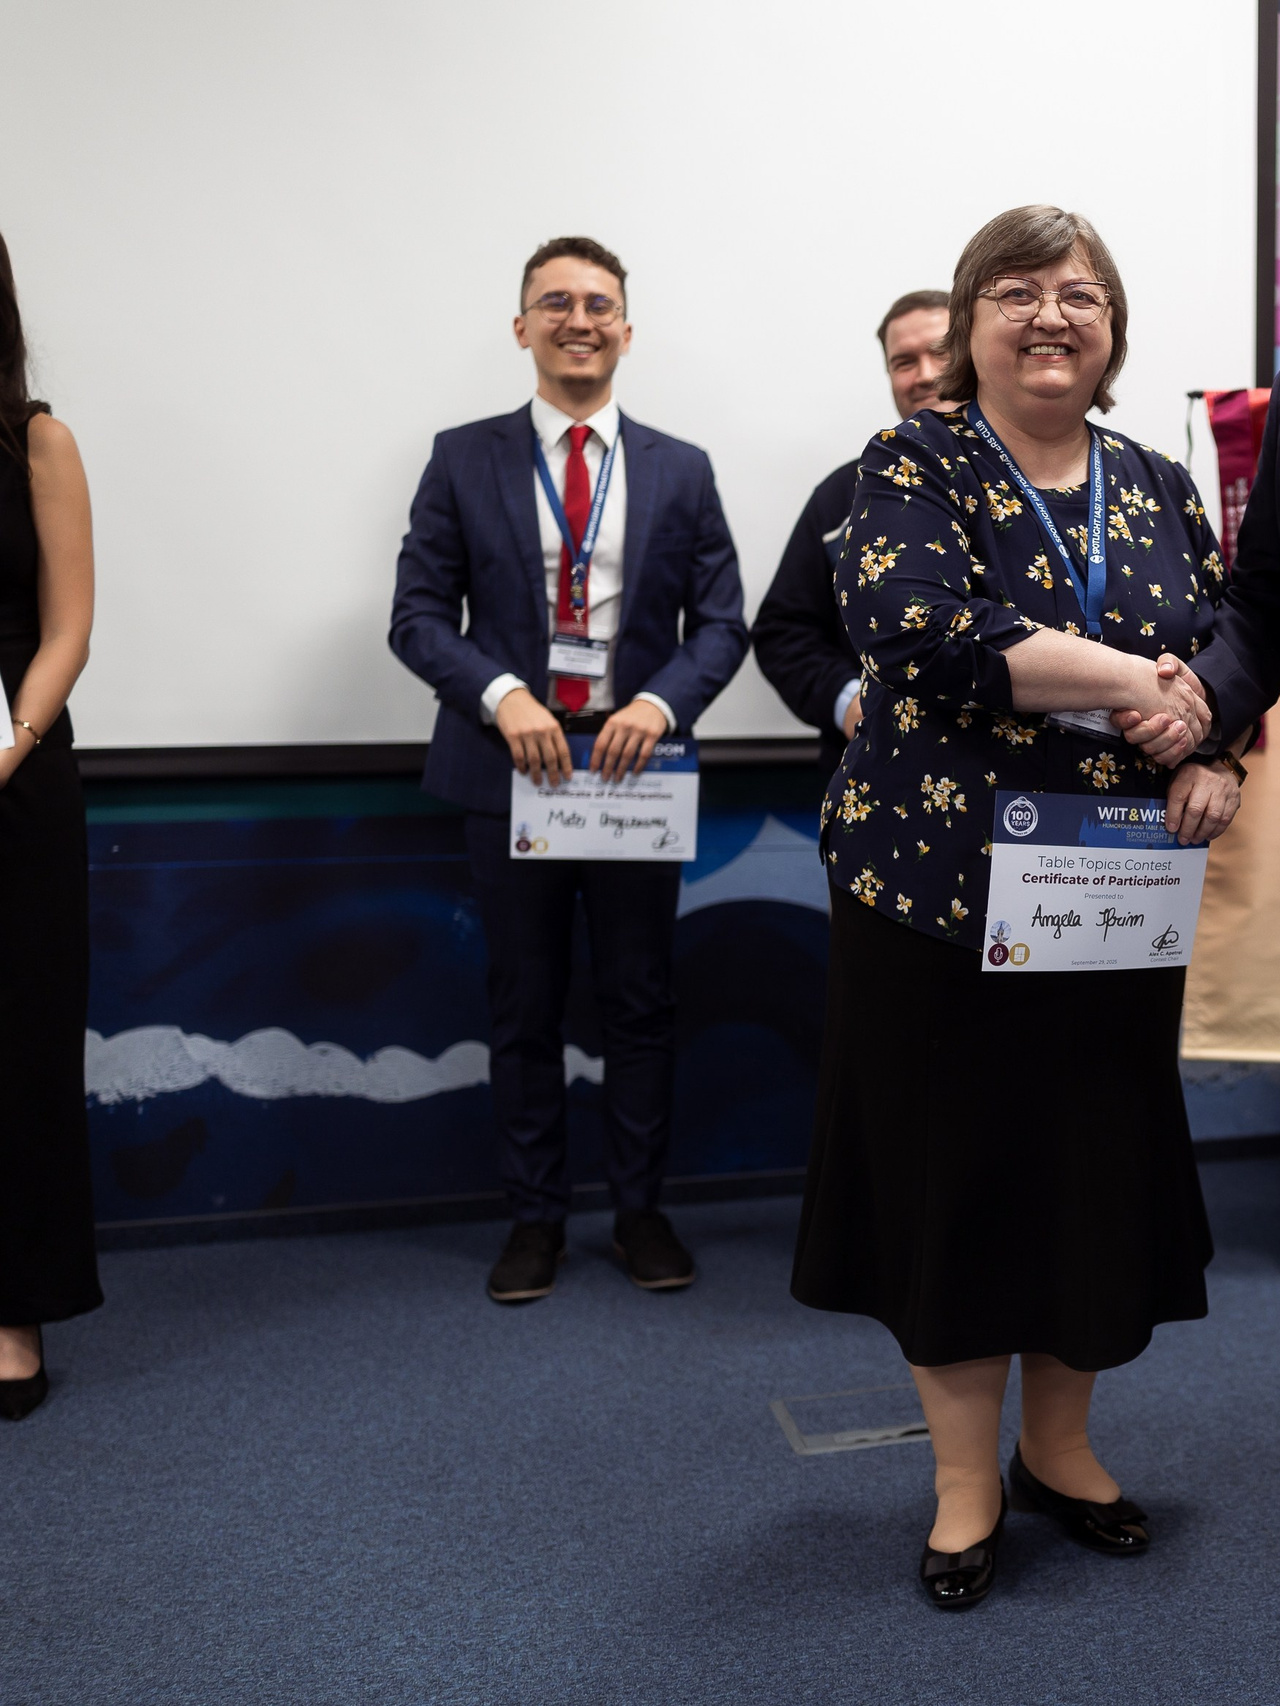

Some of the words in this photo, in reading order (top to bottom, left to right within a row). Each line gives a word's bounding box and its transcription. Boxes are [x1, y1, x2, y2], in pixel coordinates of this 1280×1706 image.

[975, 420, 990, 438] CLUB
[1094, 449, 1102, 502] TOASTMASTERS
[1092, 518, 1101, 555] SPOTLIGHT
[1010, 811, 1031, 821] 100
[1097, 806, 1167, 823] WIT&WIS
[1126, 831, 1168, 840] SPOTLIGHT
[1037, 855, 1075, 868] Table
[1079, 857, 1122, 872] Topics
[1124, 859, 1172, 871] Contest
[1021, 872, 1089, 885] Certificate
[1092, 874, 1105, 885] of
[1108, 875, 1181, 888] Participation
[1031, 903, 1082, 940] Angela
